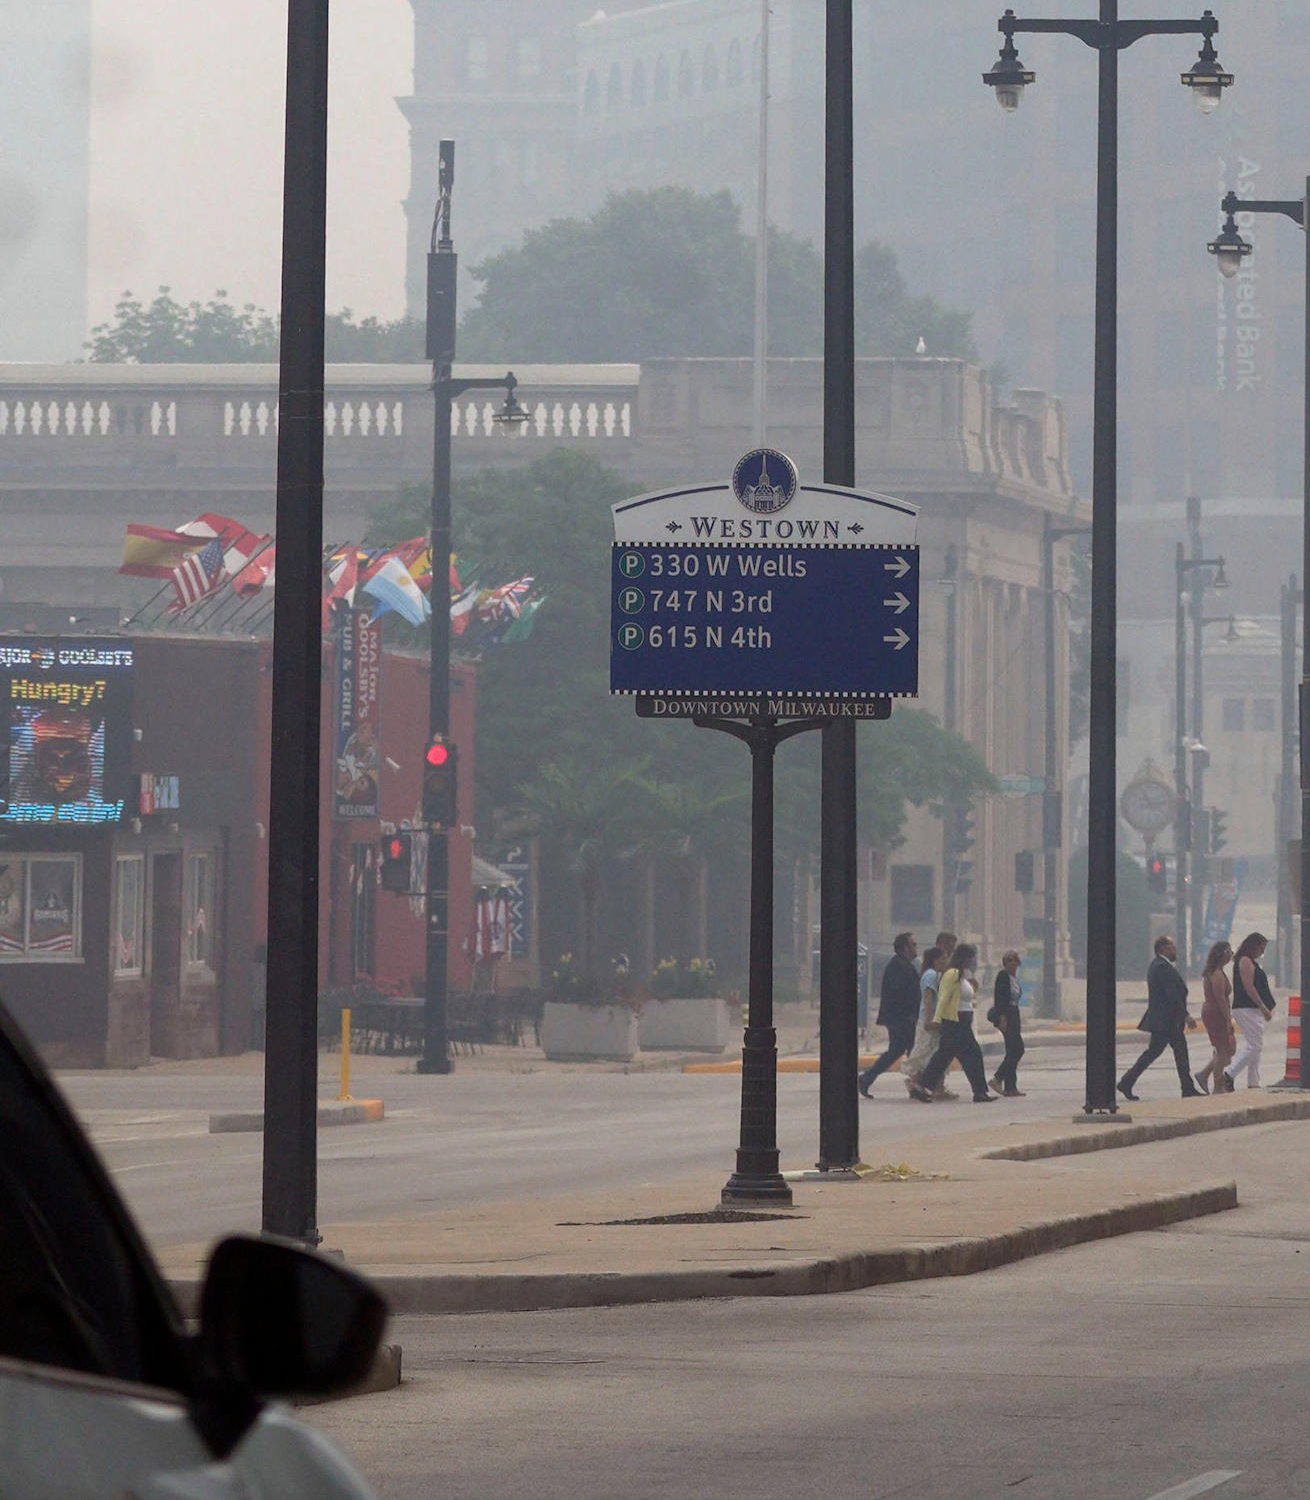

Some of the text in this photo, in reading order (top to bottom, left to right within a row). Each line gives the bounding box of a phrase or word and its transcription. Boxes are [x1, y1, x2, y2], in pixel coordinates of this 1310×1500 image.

[1236, 156, 1263, 391] Asocated Bank
[690, 516, 840, 539] WESTOWN
[650, 554, 699, 576] 330
[706, 554, 730, 576] W
[737, 554, 807, 577] Wells
[650, 590, 697, 612] 747
[706, 590, 723, 612] N
[731, 590, 772, 613] 3rd
[343, 613, 353, 651] PUB
[649, 625, 697, 648] 615
[706, 626, 722, 648] N
[730, 625, 772, 648] 4th
[368, 632, 379, 701] MAJOR
[11, 679, 106, 705] Hungry?
[341, 678, 353, 731] GRILL
[653, 699, 876, 716] DOWNTOWN MILWAUKEE
